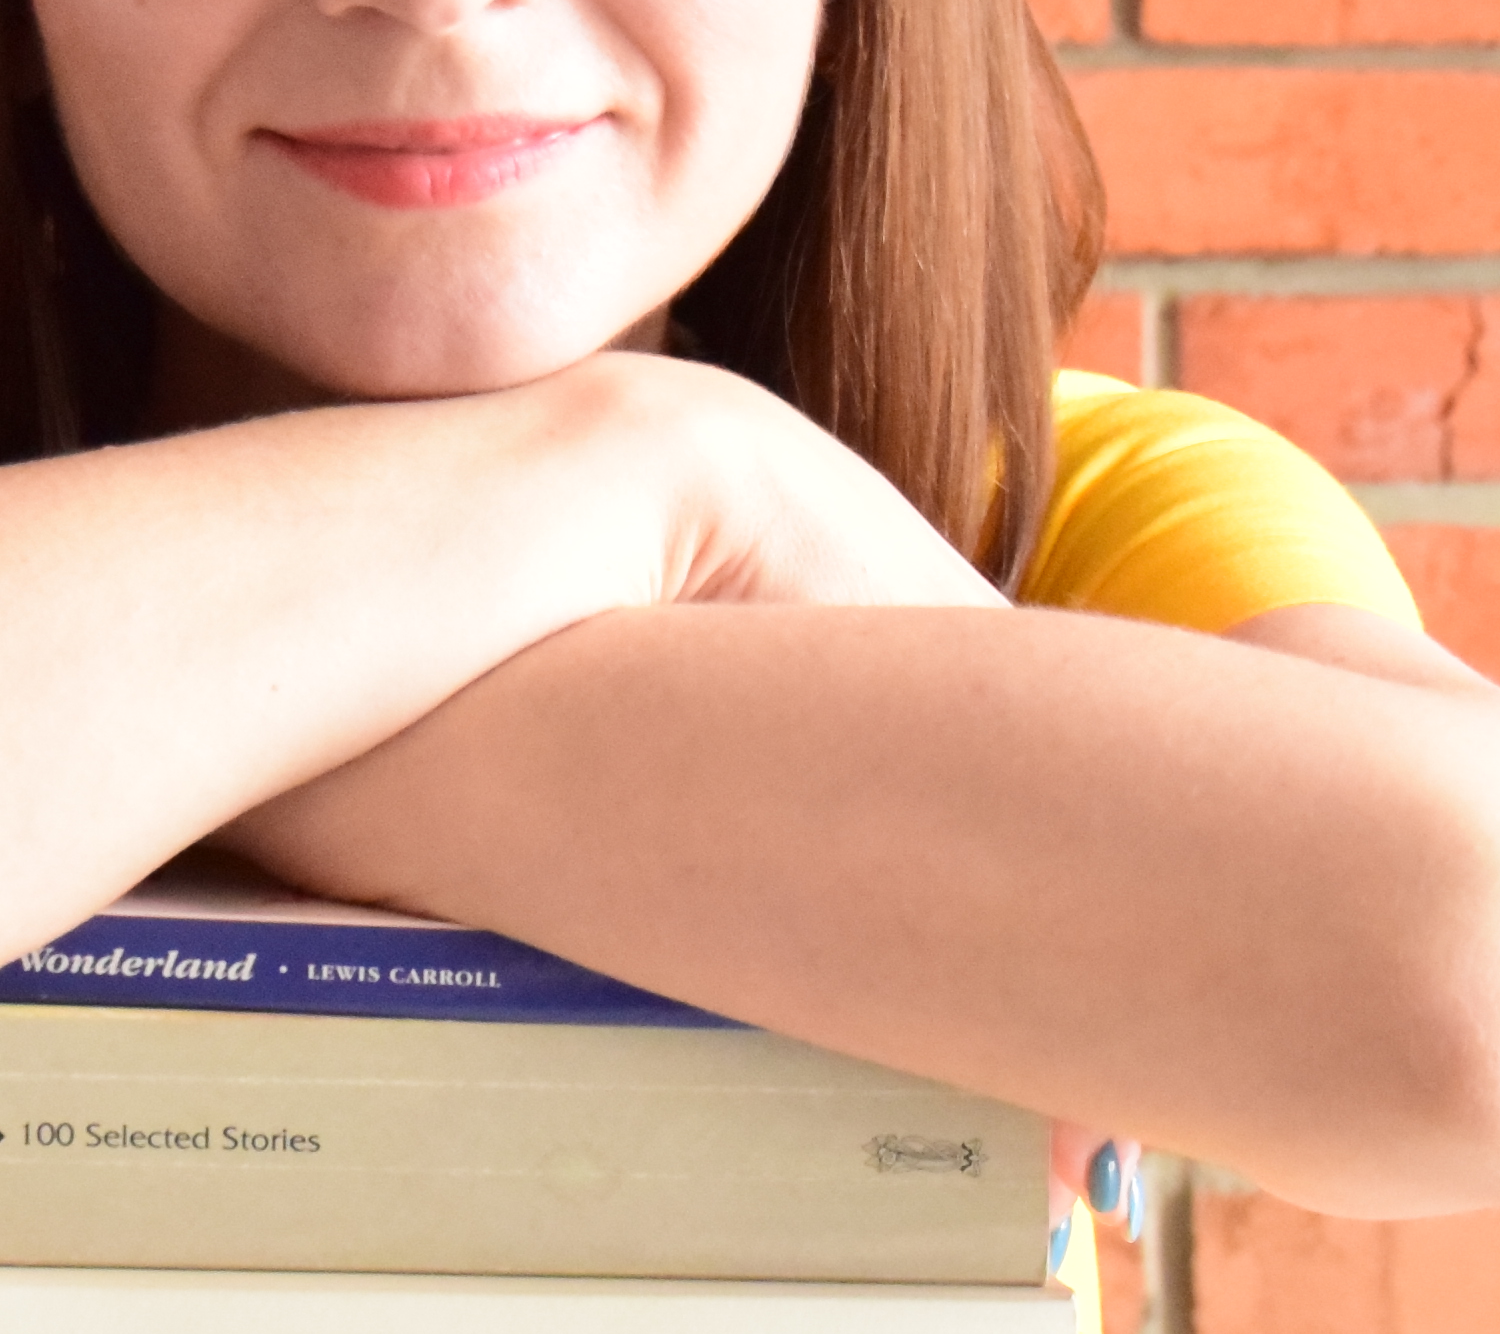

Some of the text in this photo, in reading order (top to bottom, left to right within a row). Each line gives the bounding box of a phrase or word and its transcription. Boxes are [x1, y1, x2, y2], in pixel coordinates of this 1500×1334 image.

[20, 946, 502, 989] Wonderland LEWIS CARROLL
[21, 1121, 76, 1148] 100
[85, 1121, 211, 1151] Selected
[221, 1125, 322, 1154] Stories
